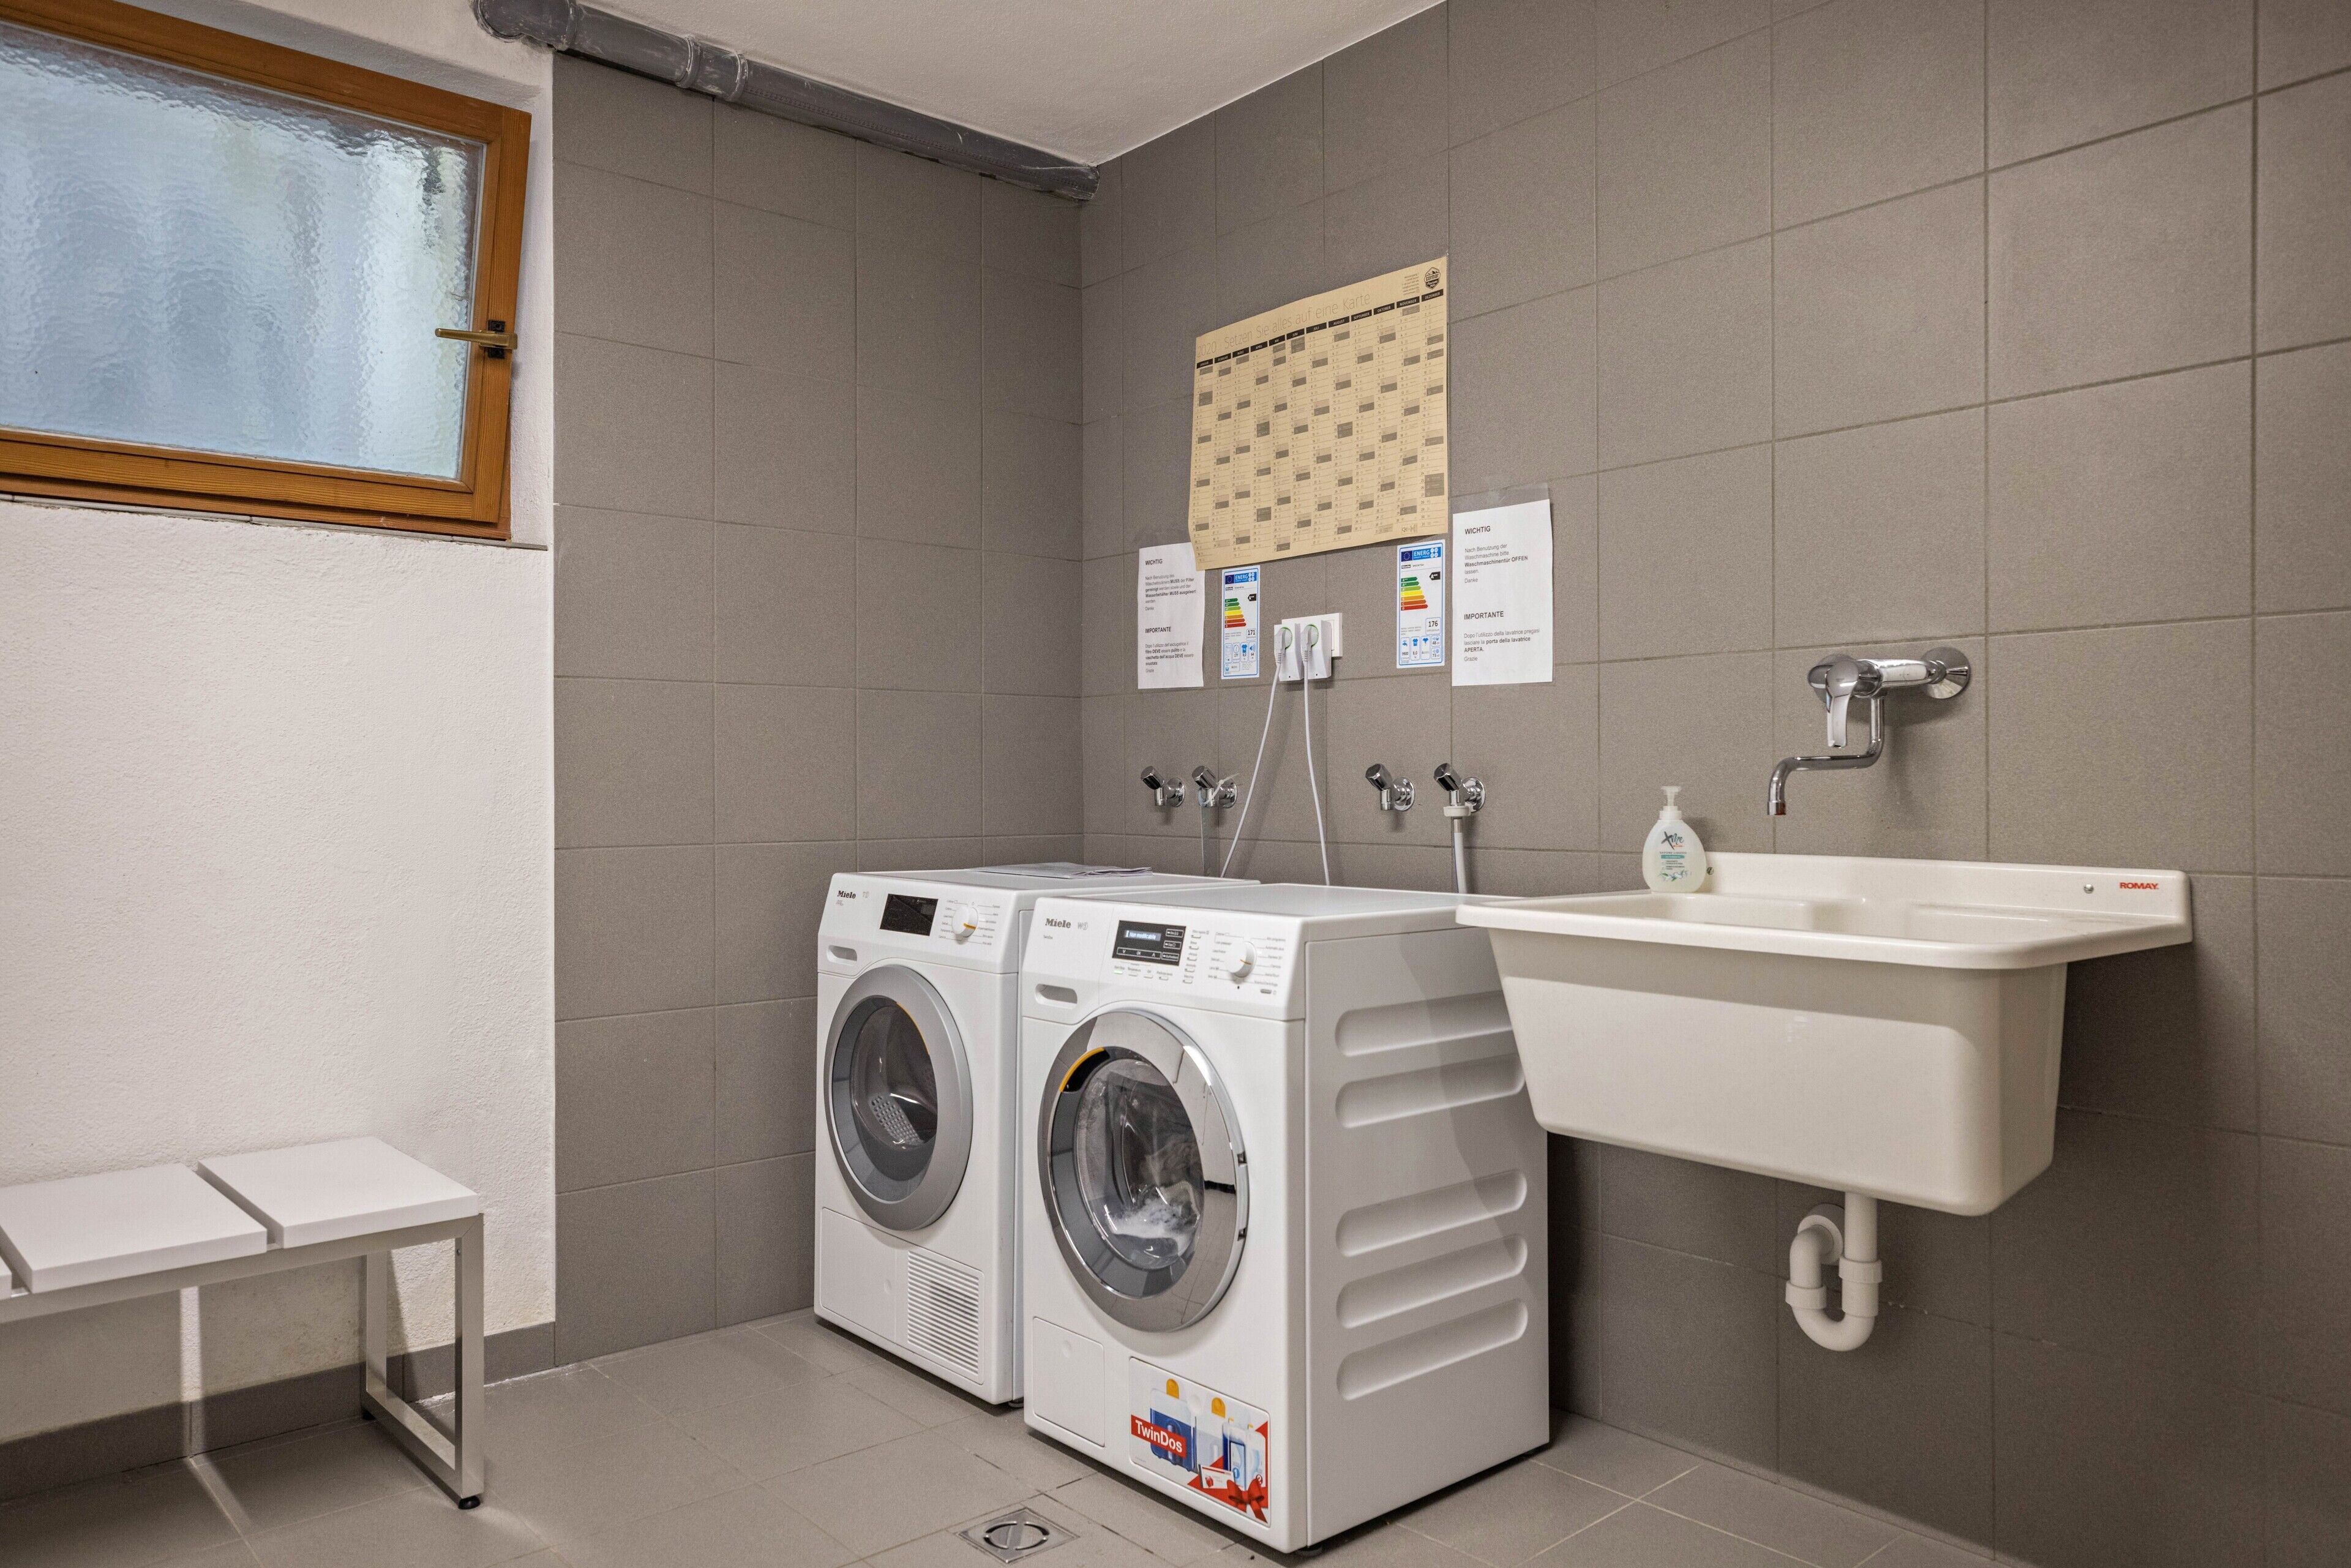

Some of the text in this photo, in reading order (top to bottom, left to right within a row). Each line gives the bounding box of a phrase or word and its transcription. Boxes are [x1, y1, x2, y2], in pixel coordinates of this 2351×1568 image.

[1198, 294, 1371, 358] 2020 Setzen Sie alles auf eine Karte
[1464, 525, 1491, 535] WICHTIG
[1464, 558, 1510, 567] Waschmaschinentür
[1464, 610, 1504, 620] IMPORTANTE
[837, 890, 856, 899] Miele
[1045, 918, 1071, 929] Miele
[1135, 1419, 1183, 1454] TwinDos
